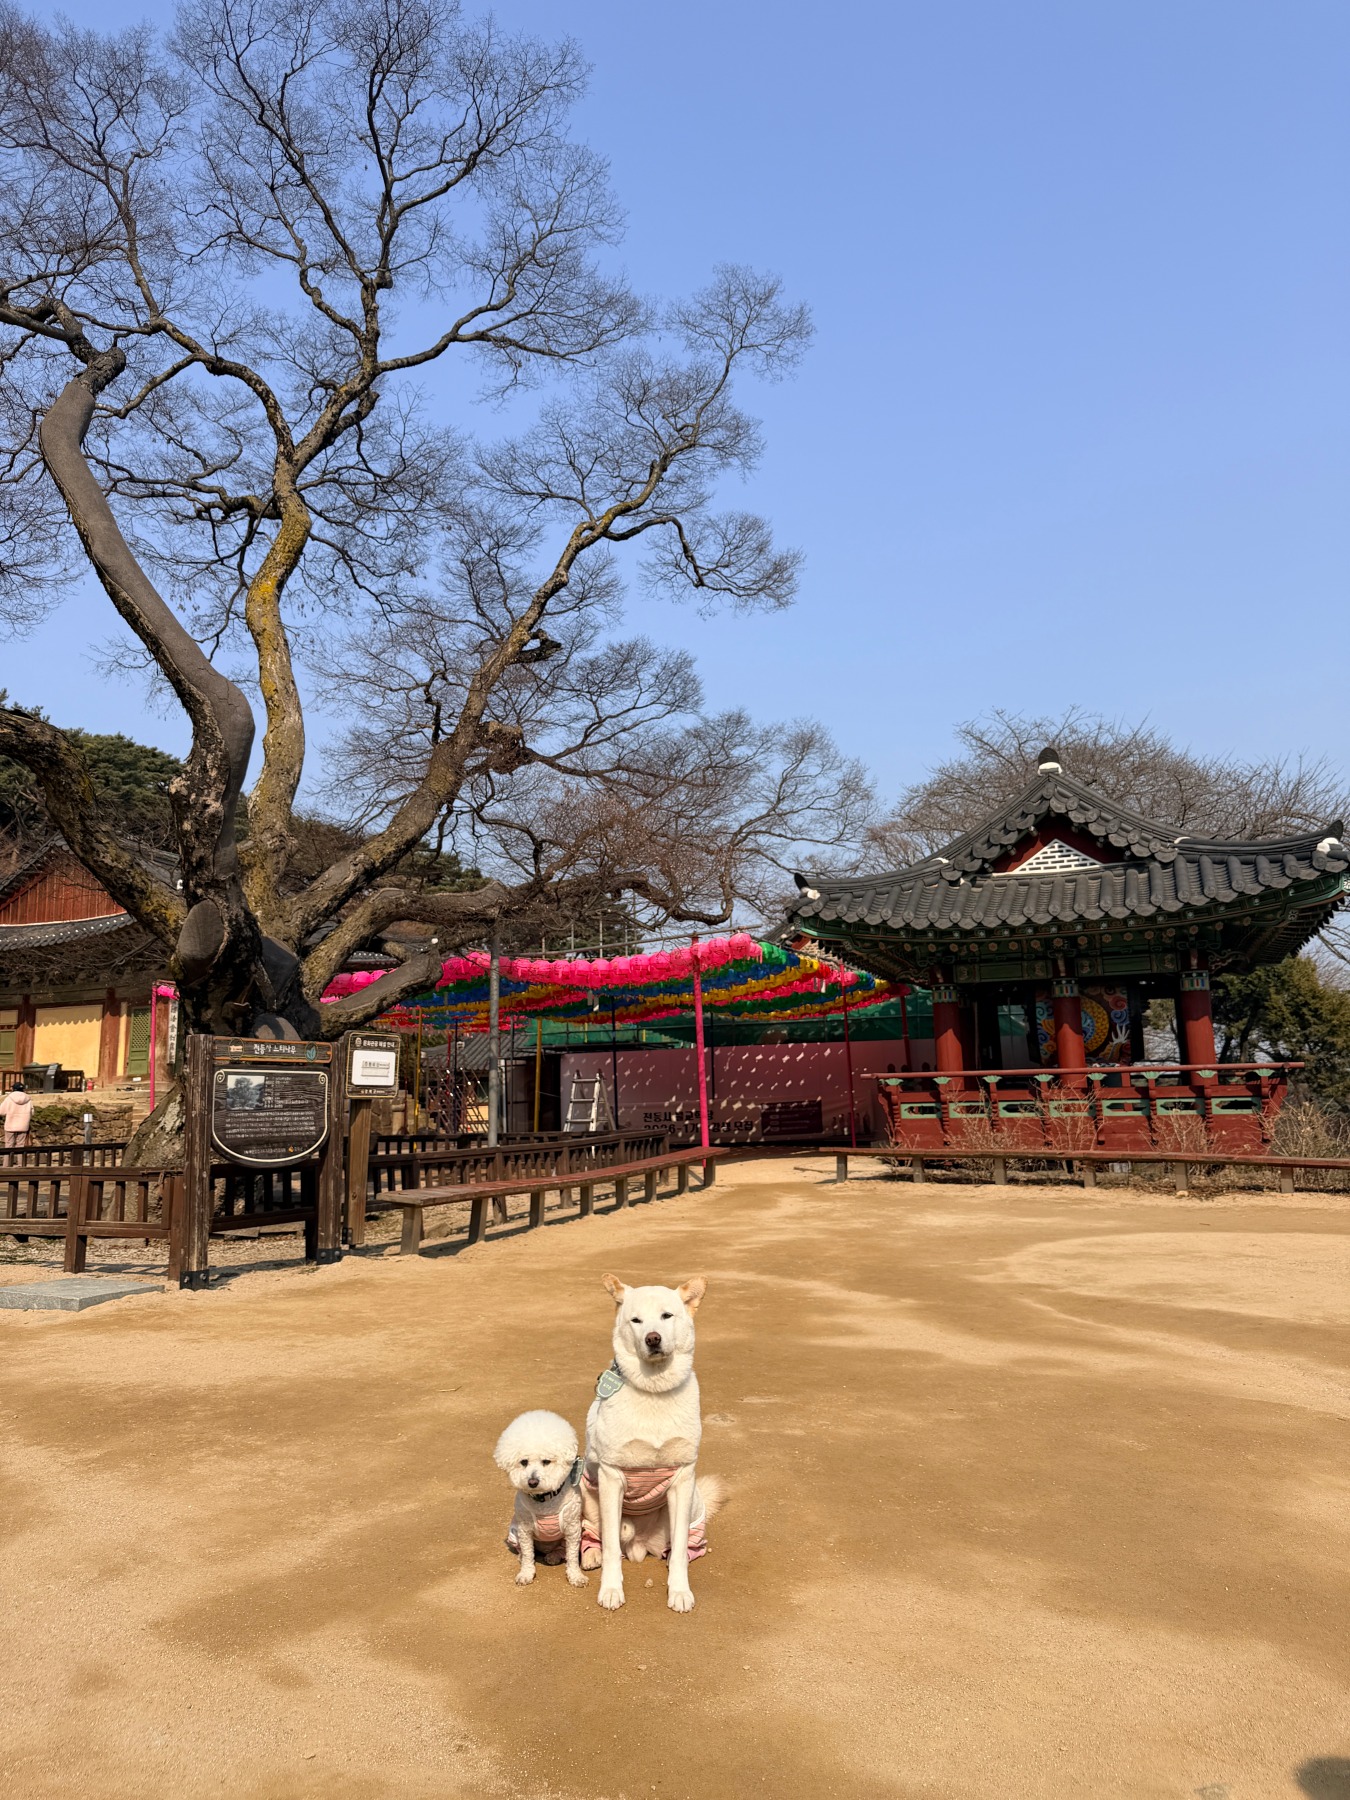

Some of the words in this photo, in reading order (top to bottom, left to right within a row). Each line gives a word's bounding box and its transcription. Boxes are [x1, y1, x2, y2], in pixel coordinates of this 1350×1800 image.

[253, 1043, 272, 1055] 전등사
[273, 1044, 297, 1055] 느티나무
[733, 1120, 754, 1131] 모집
